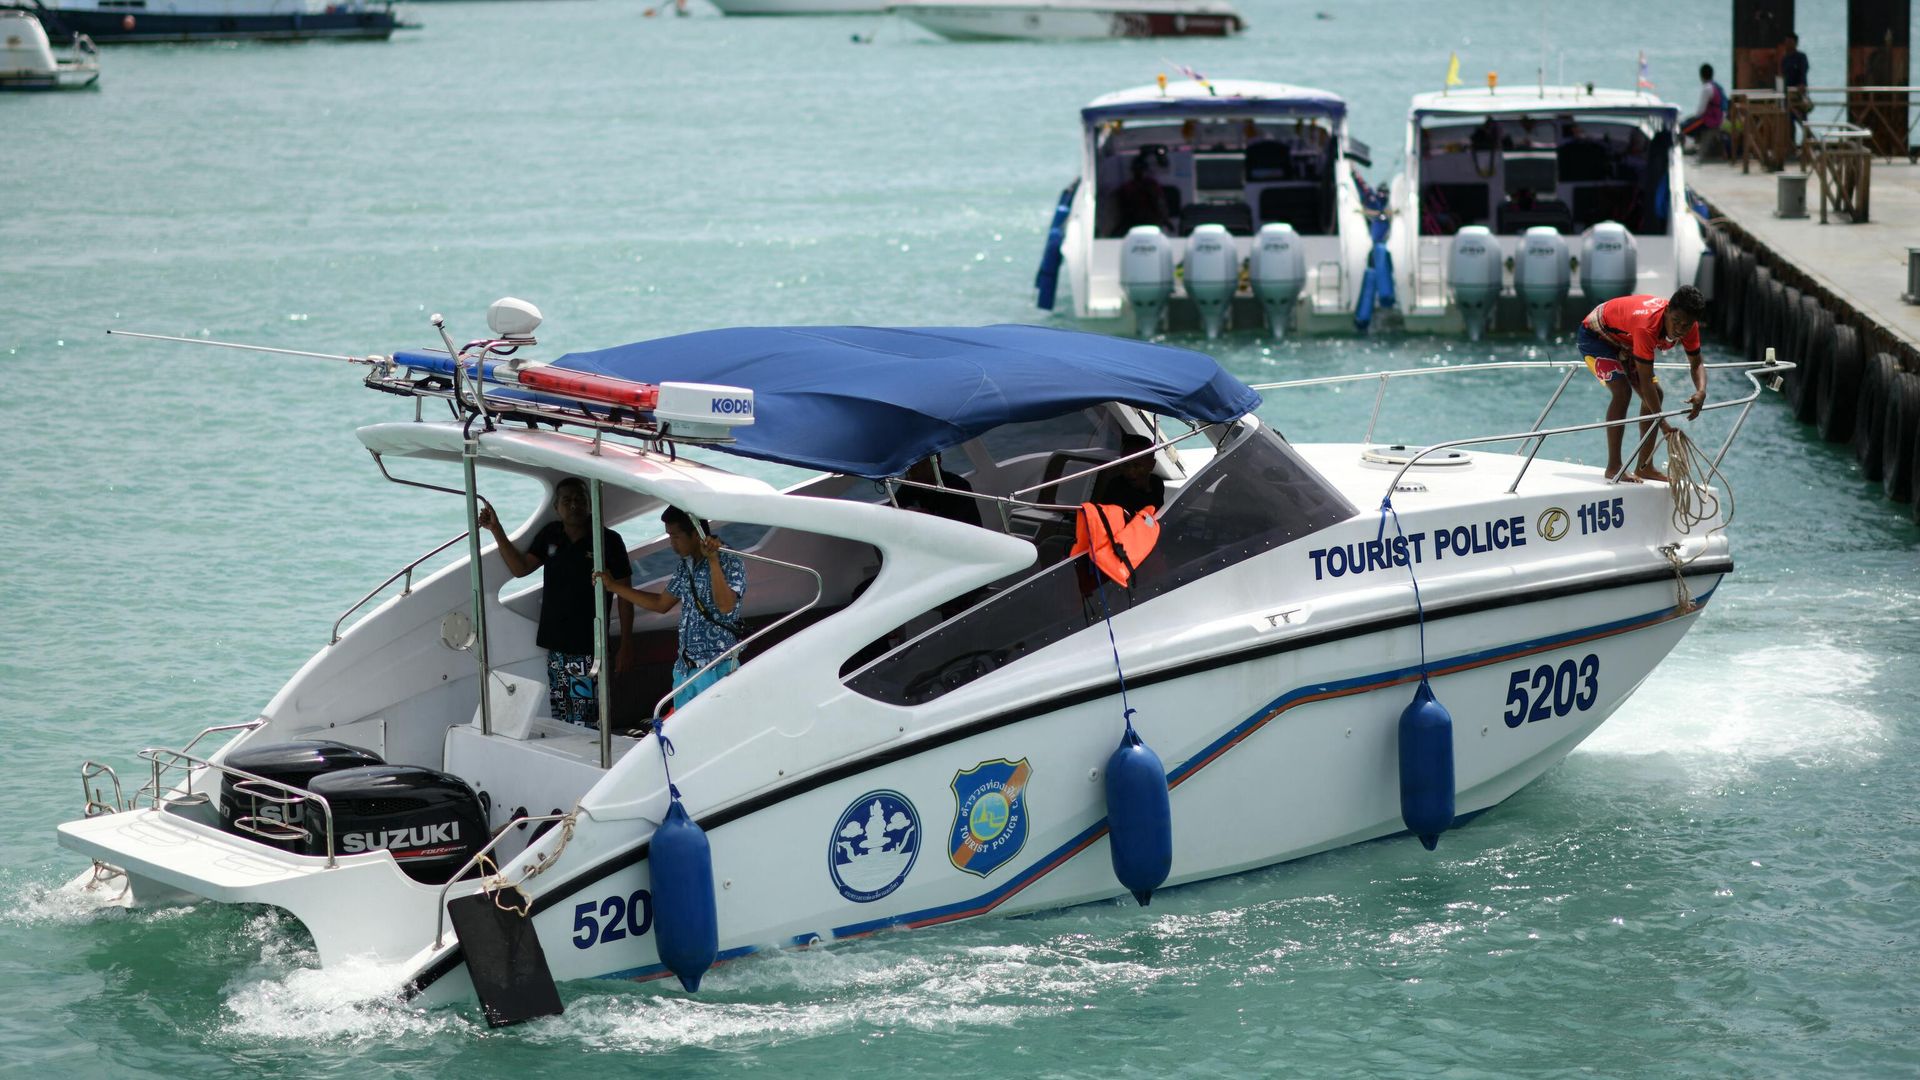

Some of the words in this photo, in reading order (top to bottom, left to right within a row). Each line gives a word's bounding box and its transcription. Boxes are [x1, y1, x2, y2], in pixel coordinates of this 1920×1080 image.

[711, 398, 752, 413] KODEN
[1577, 497, 1625, 536] 1155
[1309, 532, 1426, 581] TOURIST
[1434, 515, 1527, 561] POLICE
[1504, 653, 1600, 728] 5203
[342, 821, 460, 853] SUZUKI
[960, 824, 989, 853] TOURIST
[992, 815, 1019, 850] POLICE
[572, 889, 654, 950] 520
